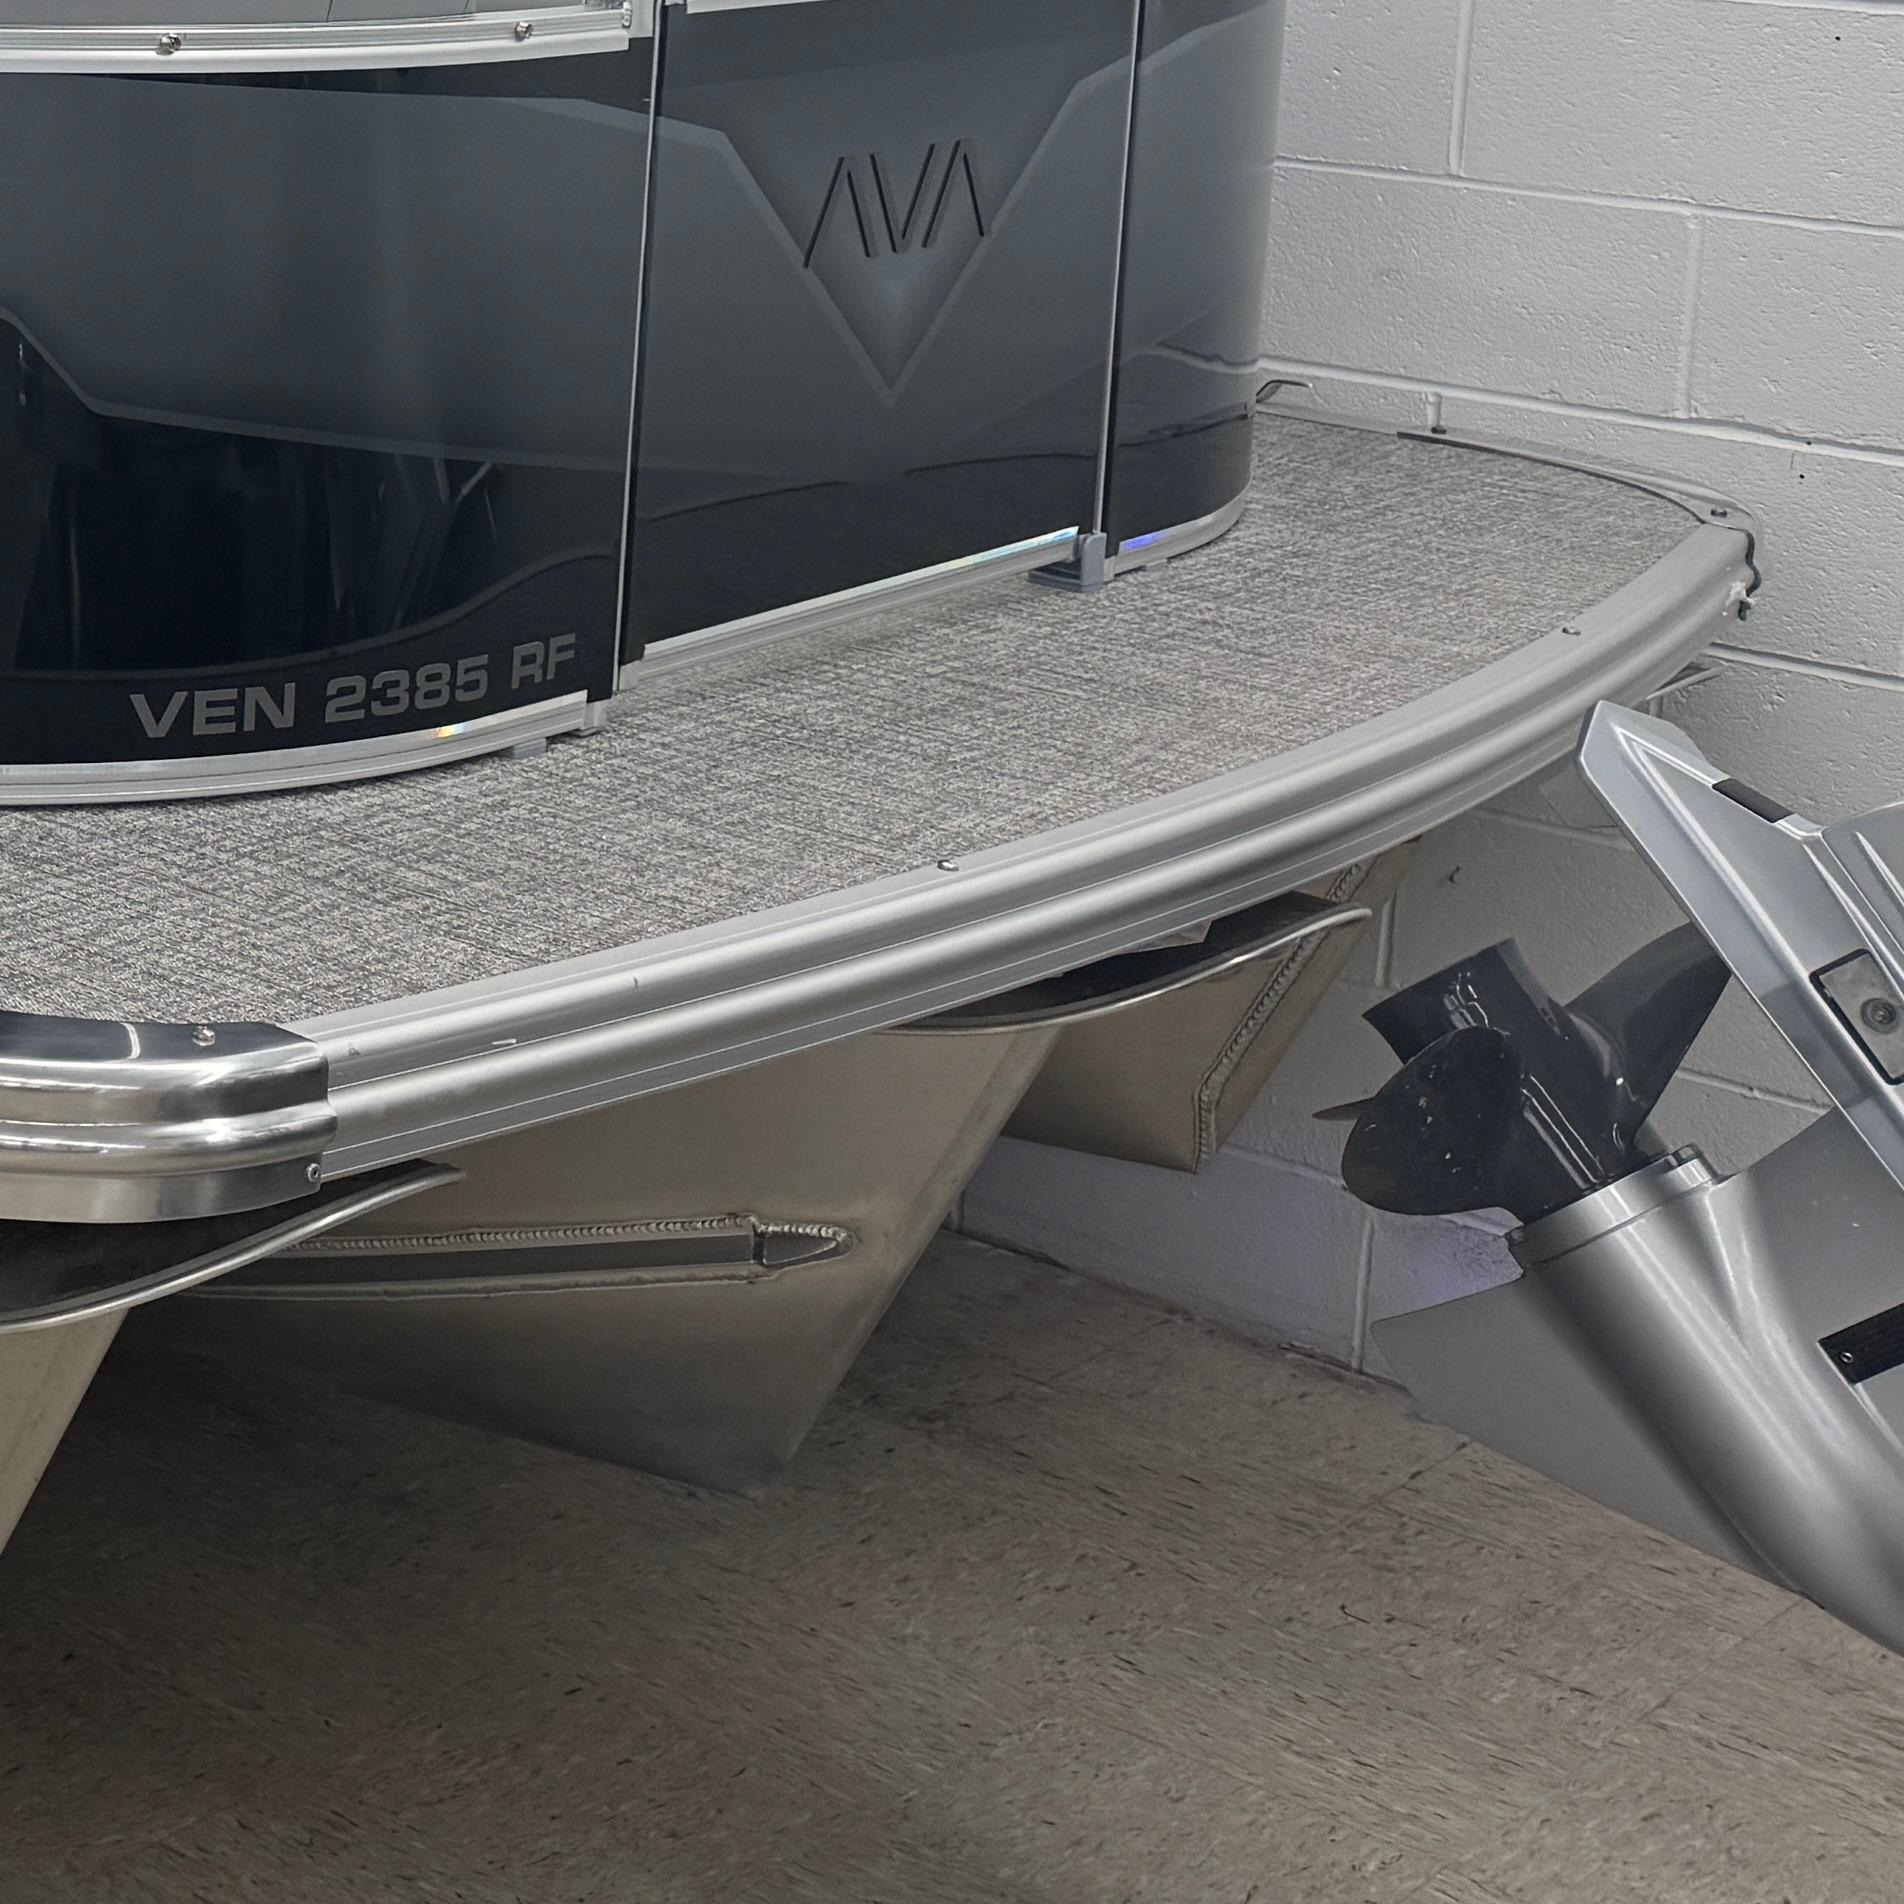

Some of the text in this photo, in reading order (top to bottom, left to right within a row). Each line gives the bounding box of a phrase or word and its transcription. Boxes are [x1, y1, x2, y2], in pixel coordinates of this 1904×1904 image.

[802, 138, 985, 270] AVA
[129, 632, 578, 739] VEN 2385 RF
